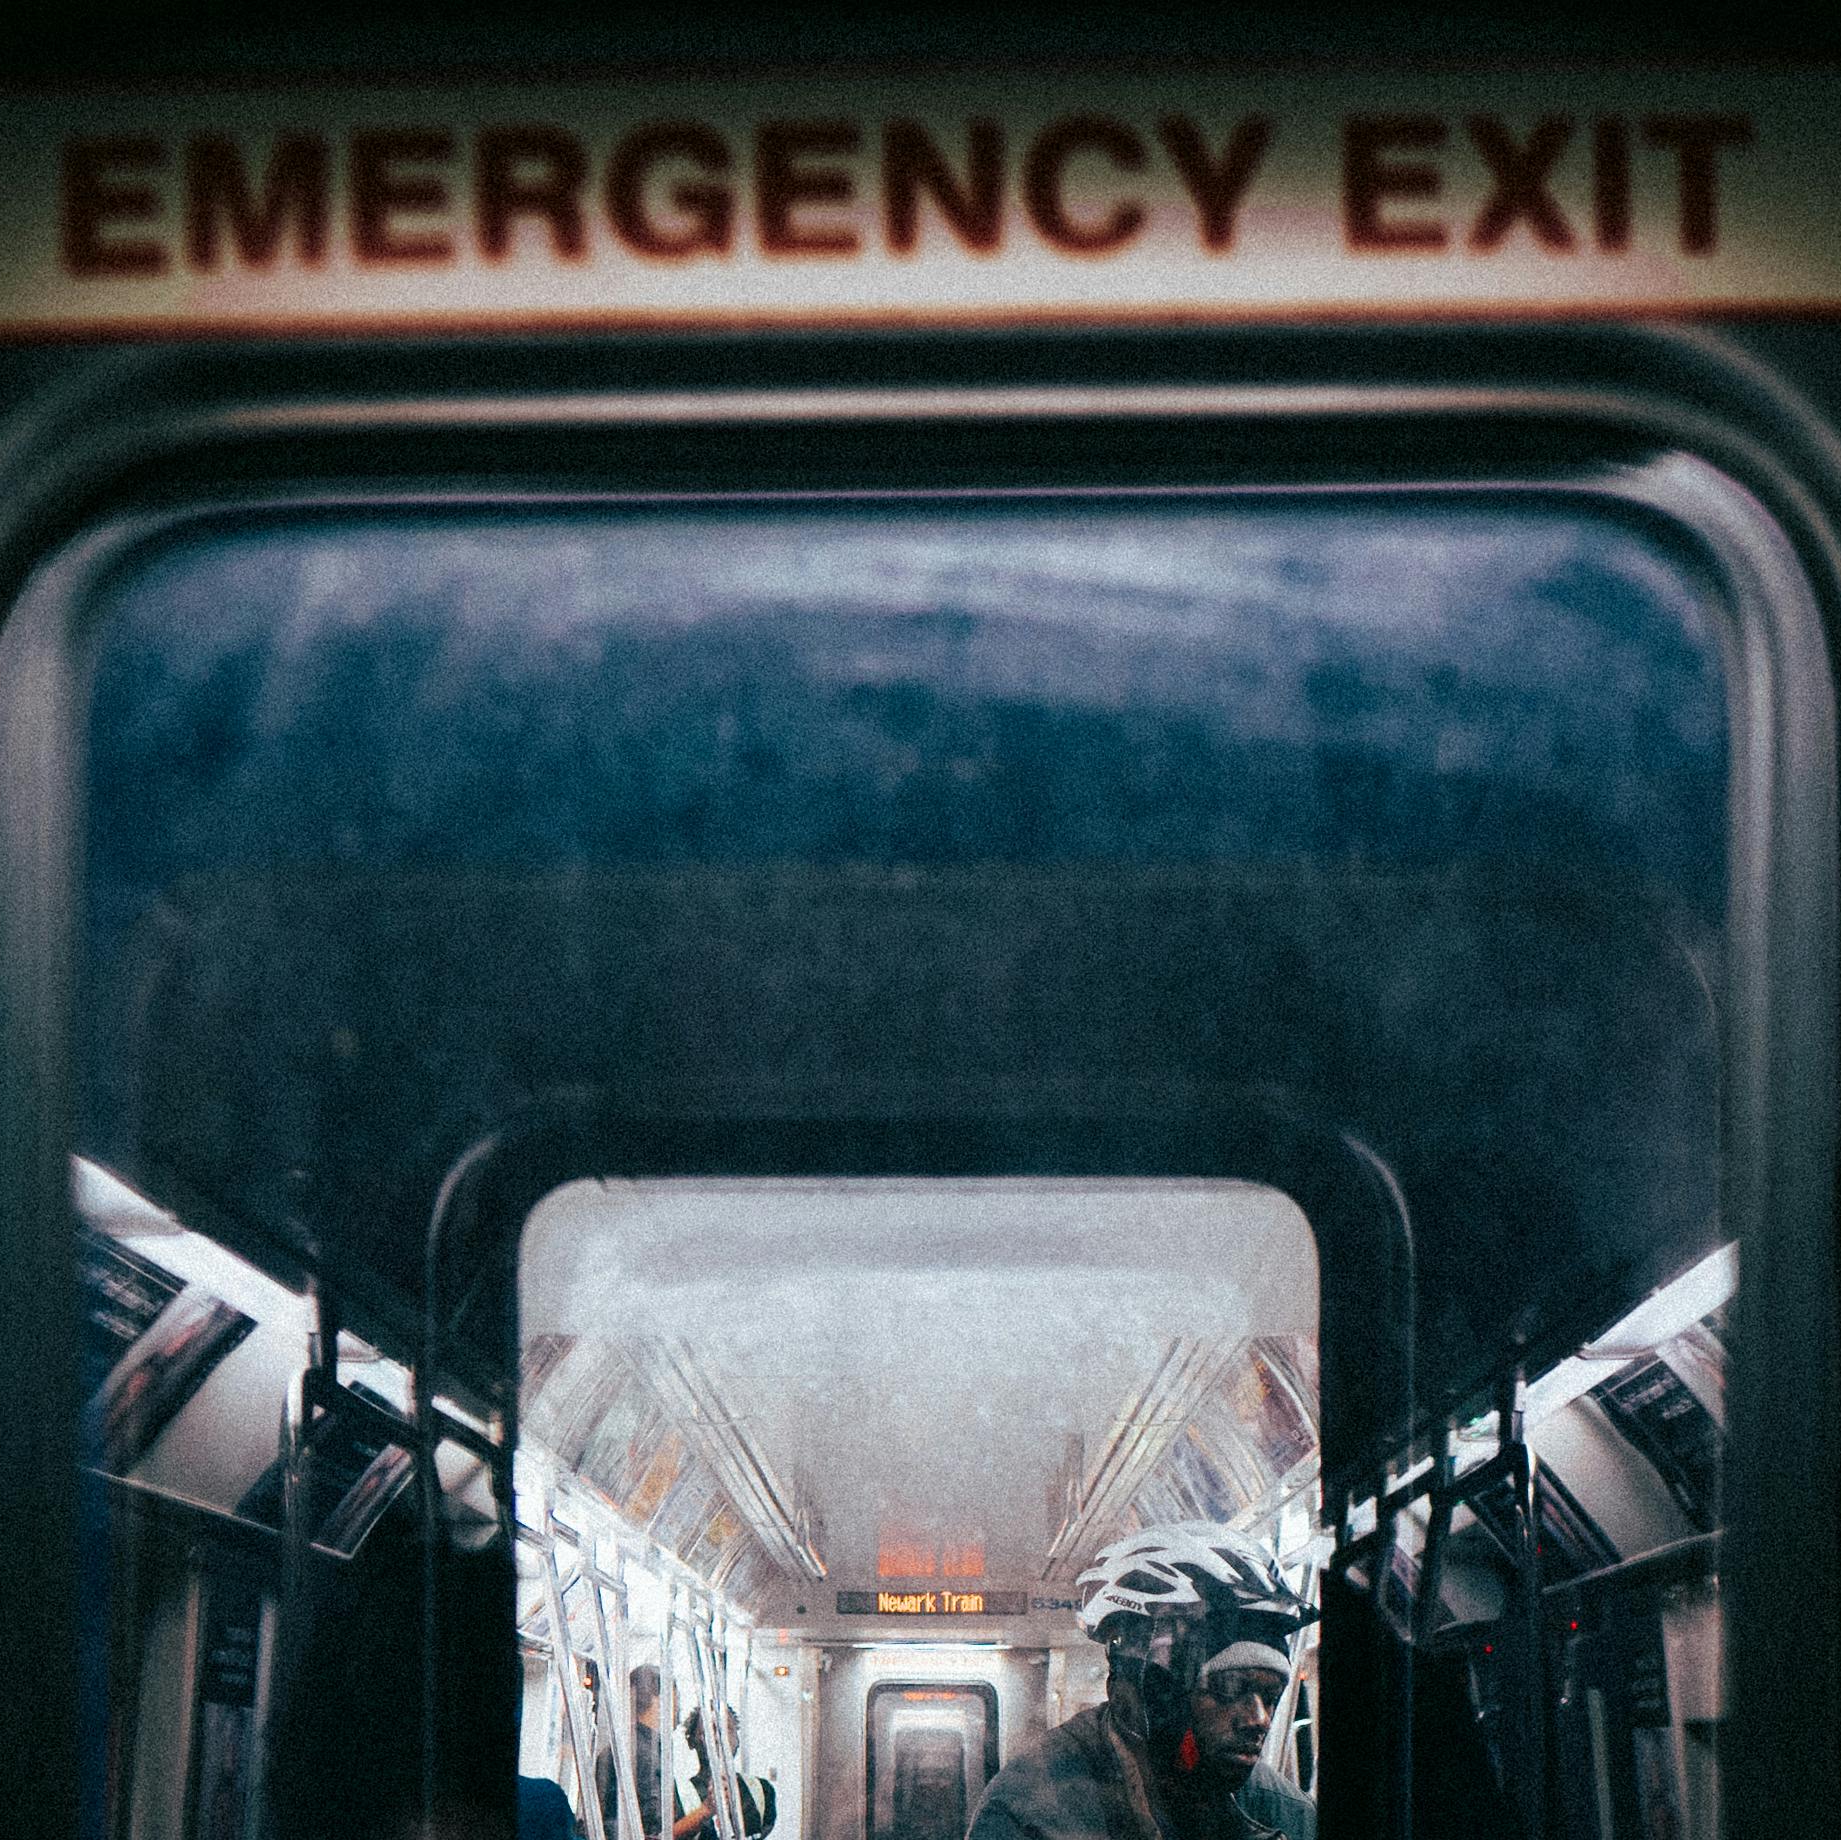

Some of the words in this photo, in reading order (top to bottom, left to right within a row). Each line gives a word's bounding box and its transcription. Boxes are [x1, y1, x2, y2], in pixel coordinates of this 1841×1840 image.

[61, 112, 1272, 278] EMERGENCY
[1340, 110, 1756, 256] EXIT
[878, 1592, 937, 1613] Newark
[940, 1590, 984, 1613] Train
